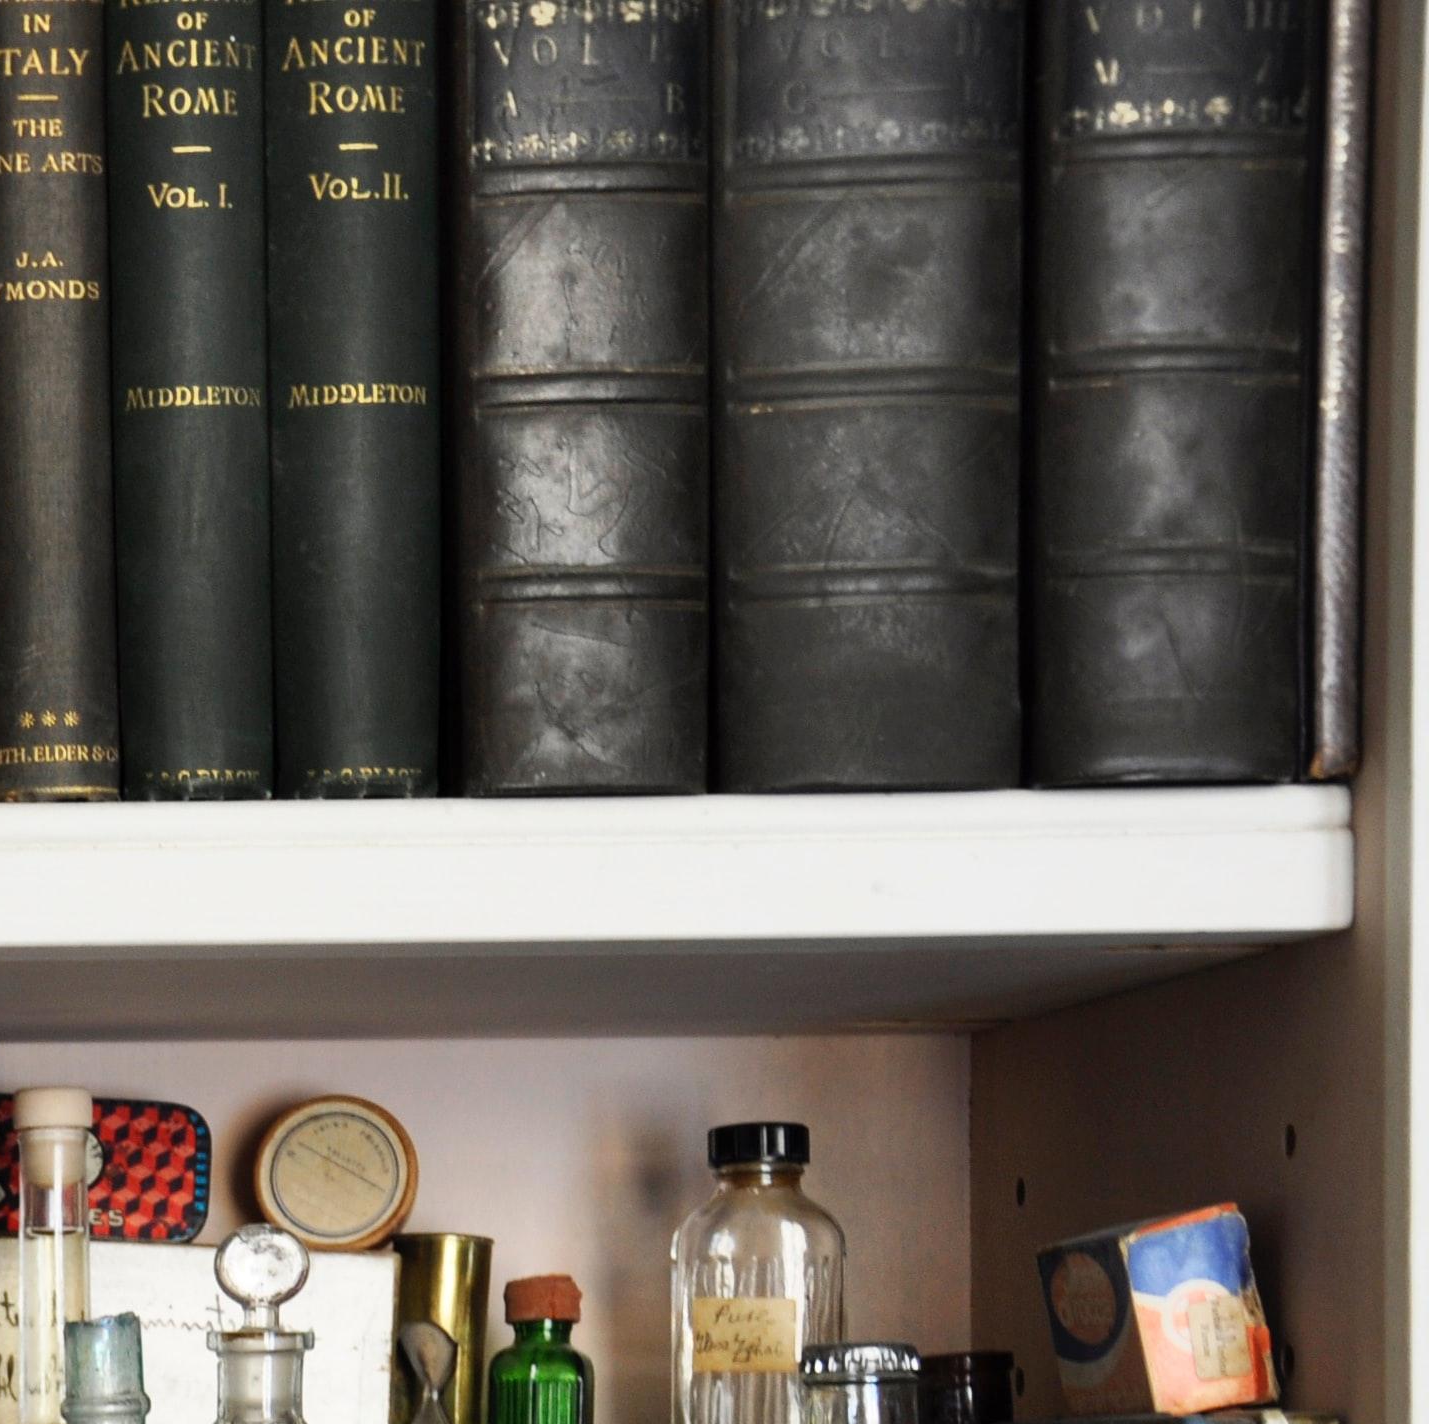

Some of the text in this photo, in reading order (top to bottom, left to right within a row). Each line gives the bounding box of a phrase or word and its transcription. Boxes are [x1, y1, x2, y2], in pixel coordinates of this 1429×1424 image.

[22, 14, 52, 34] IN
[176, 11, 209, 32] OF
[116, 39, 257, 75] ANCIENT
[142, 84, 239, 118] ROME
[308, 81, 406, 116] ROME
[13, 118, 64, 138] THE
[41, 153, 104, 176] ARTS
[125, 385, 261, 412] MIDDLETON
[287, 383, 428, 409] MIDDLETON
